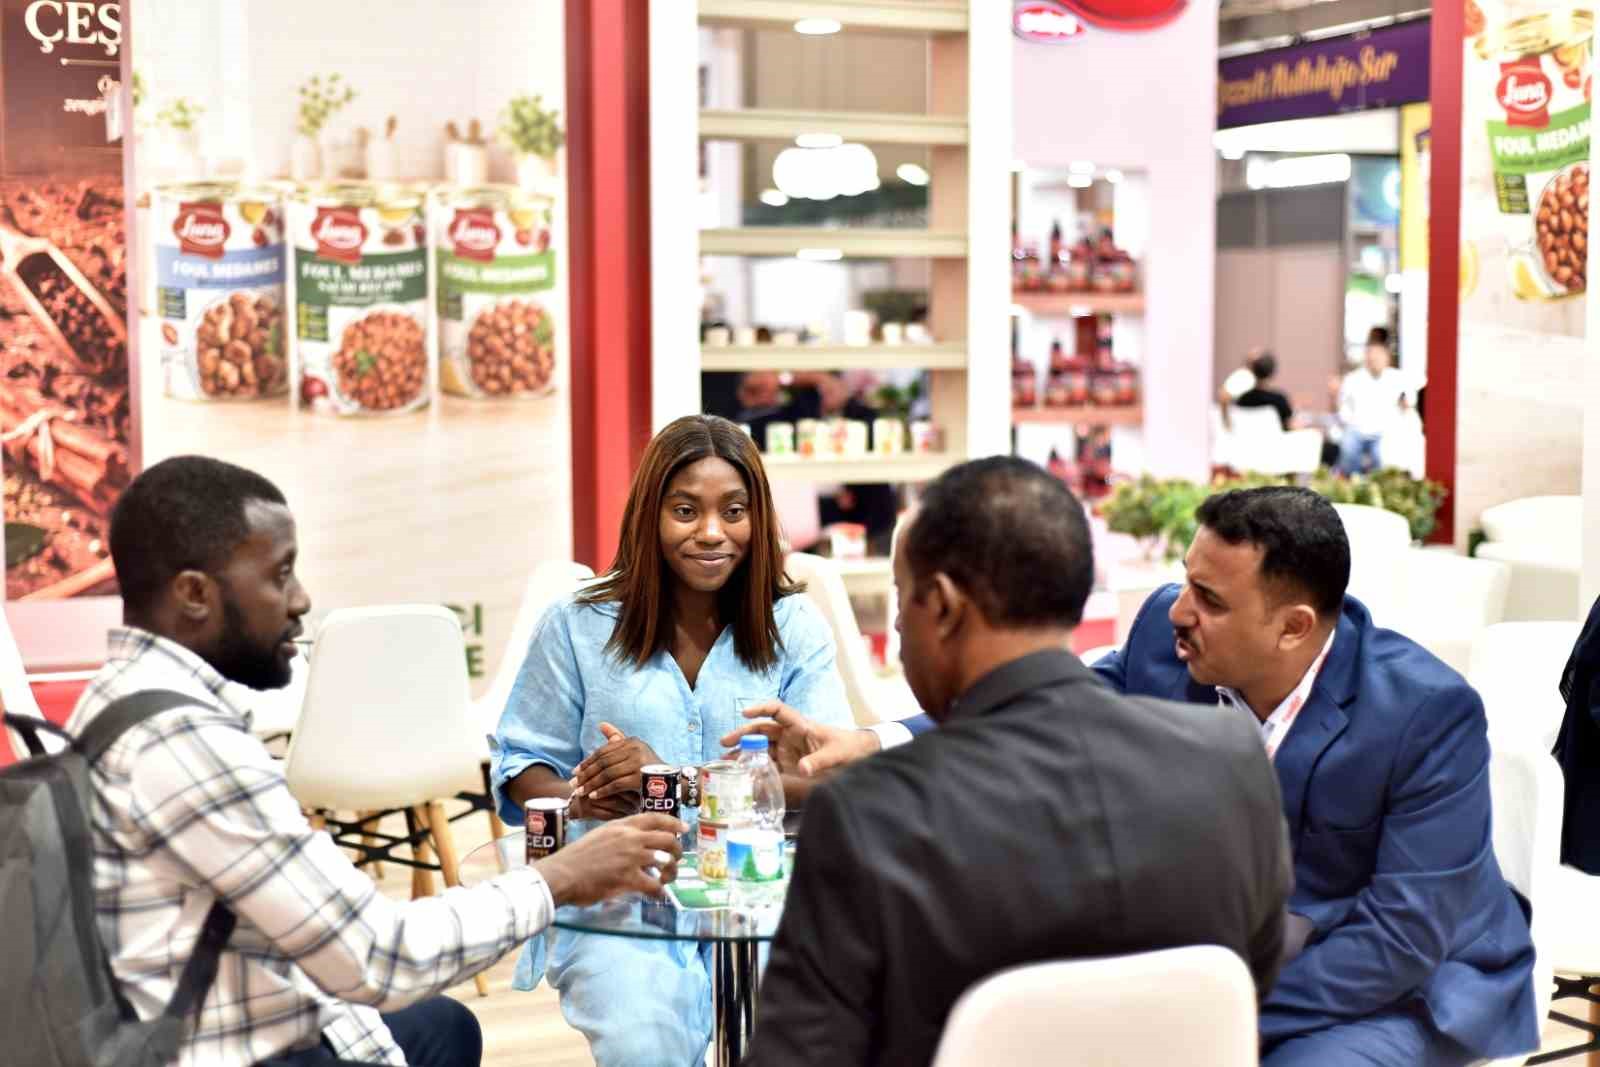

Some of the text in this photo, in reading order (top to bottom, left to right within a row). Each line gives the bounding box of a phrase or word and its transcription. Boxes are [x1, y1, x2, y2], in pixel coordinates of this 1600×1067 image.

[24, 0, 122, 56] ÇEŞ
[1494, 135, 1535, 156] FOUL
[173, 259, 208, 278] FOUL
[641, 798, 674, 809] ICED
